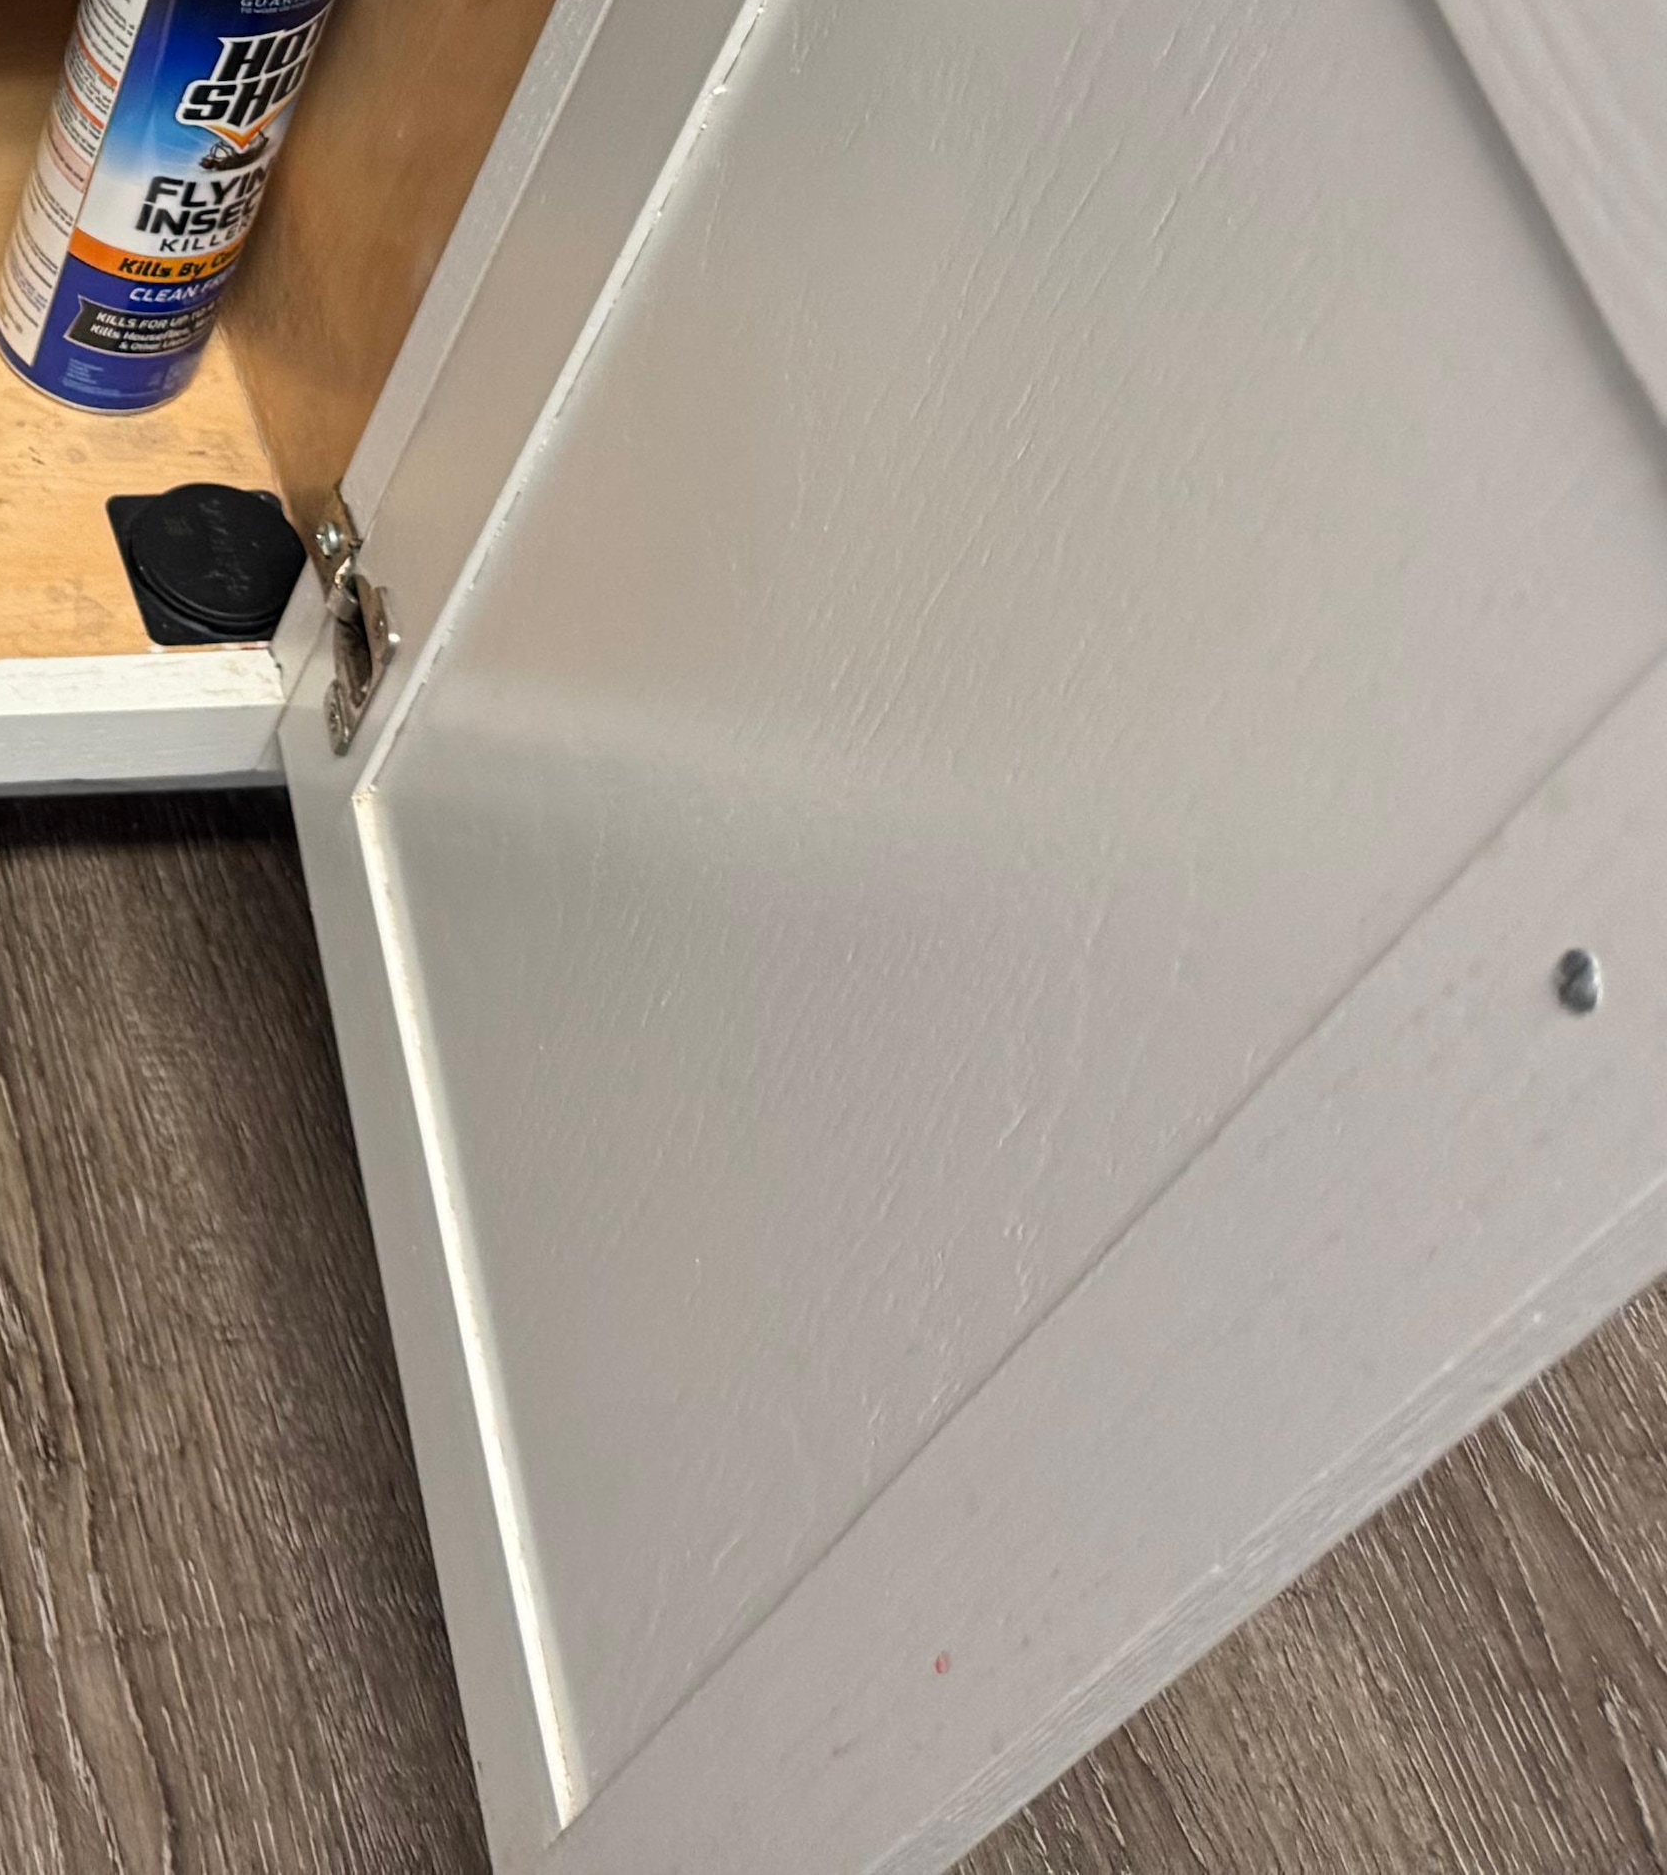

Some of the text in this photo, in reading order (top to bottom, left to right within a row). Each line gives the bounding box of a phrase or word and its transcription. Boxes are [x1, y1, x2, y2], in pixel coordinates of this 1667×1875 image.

[146, 167, 267, 208] FLYIN
[135, 185, 265, 236] INSEC
[119, 257, 208, 278] Kills By
[129, 284, 200, 303] CLEAN
[96, 311, 138, 328] KILLS
[90, 324, 122, 340] Kills
